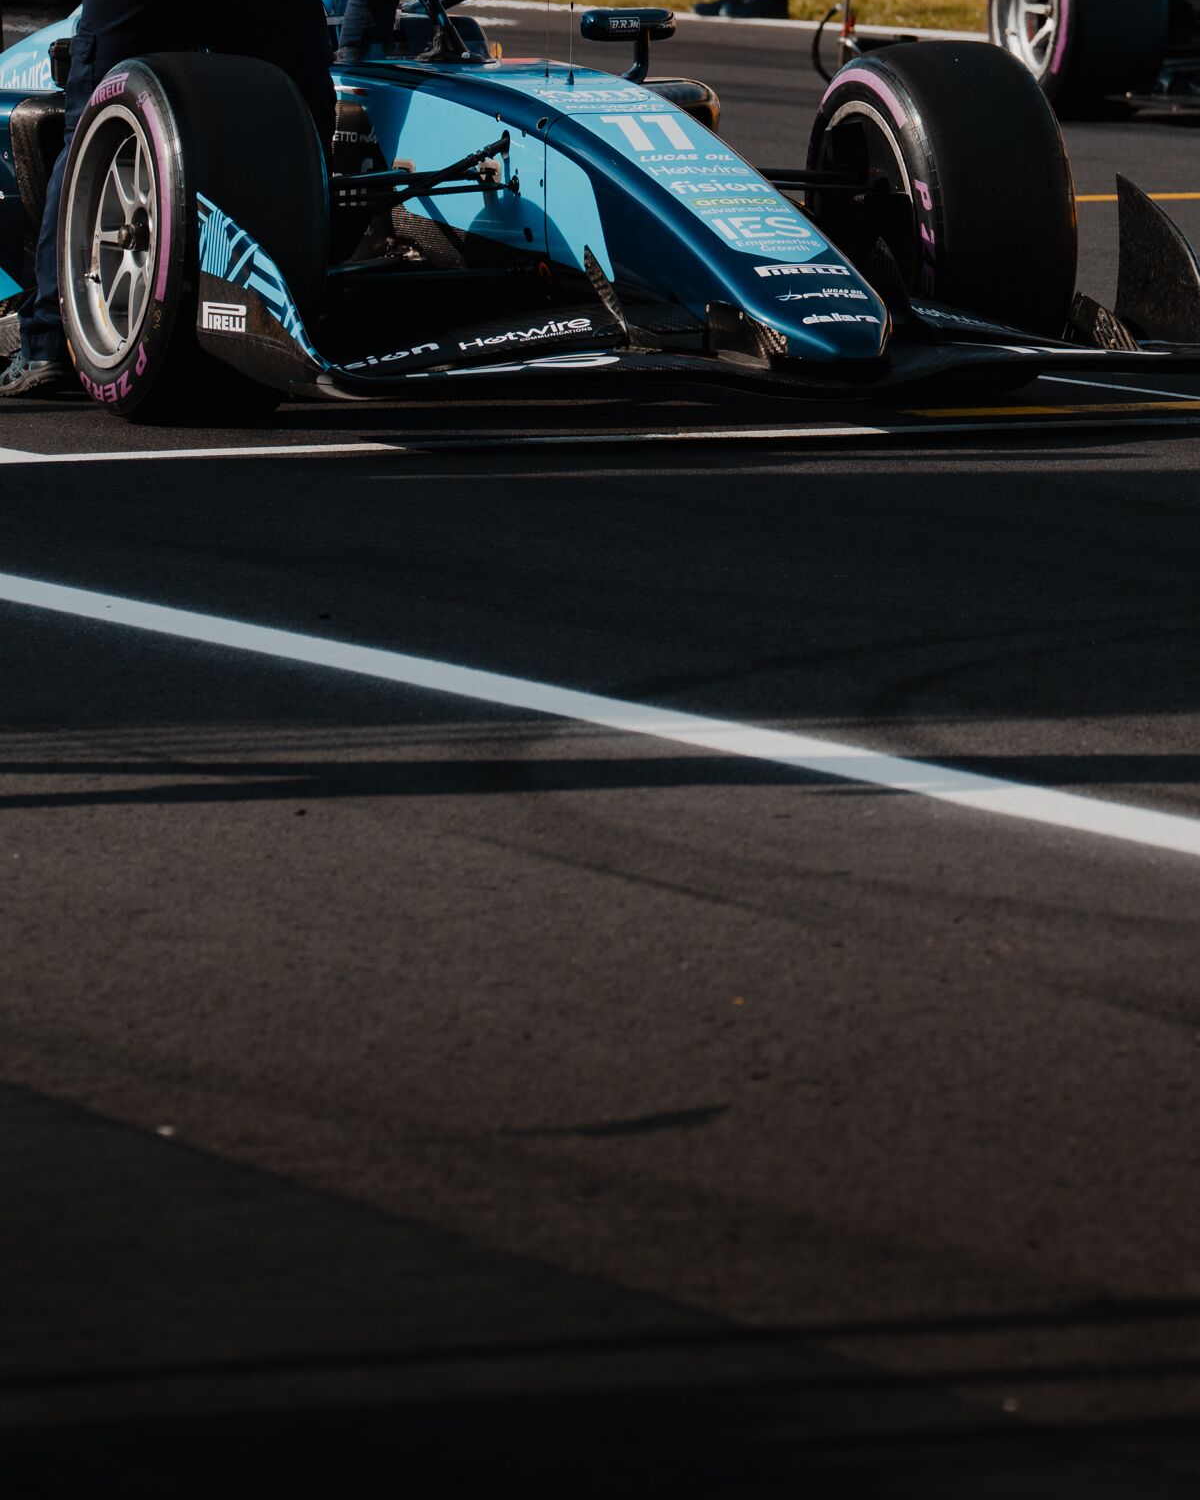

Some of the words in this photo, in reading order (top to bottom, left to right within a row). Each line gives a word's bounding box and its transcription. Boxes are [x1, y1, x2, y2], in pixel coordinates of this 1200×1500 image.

[90, 72, 130, 108] PIRELLI
[600, 114, 696, 151] 11
[639, 153, 699, 162] LUCAS
[704, 153, 734, 162] OIL
[649, 163, 750, 177] Hotwire
[669, 179, 772, 195] fision
[695, 197, 778, 207] aramco
[699, 206, 764, 216] advanced
[764, 205, 793, 214] fuel
[711, 216, 812, 240] IES
[735, 239, 820, 249] Empowering
[760, 245, 811, 253] Growth
[754, 263, 851, 278] PIRELLI
[202, 301, 247, 333] PIRELLI
[802, 312, 881, 325] dallara
[458, 316, 592, 351] Hotwire
[519, 326, 593, 343] COMMUNICATIONS
